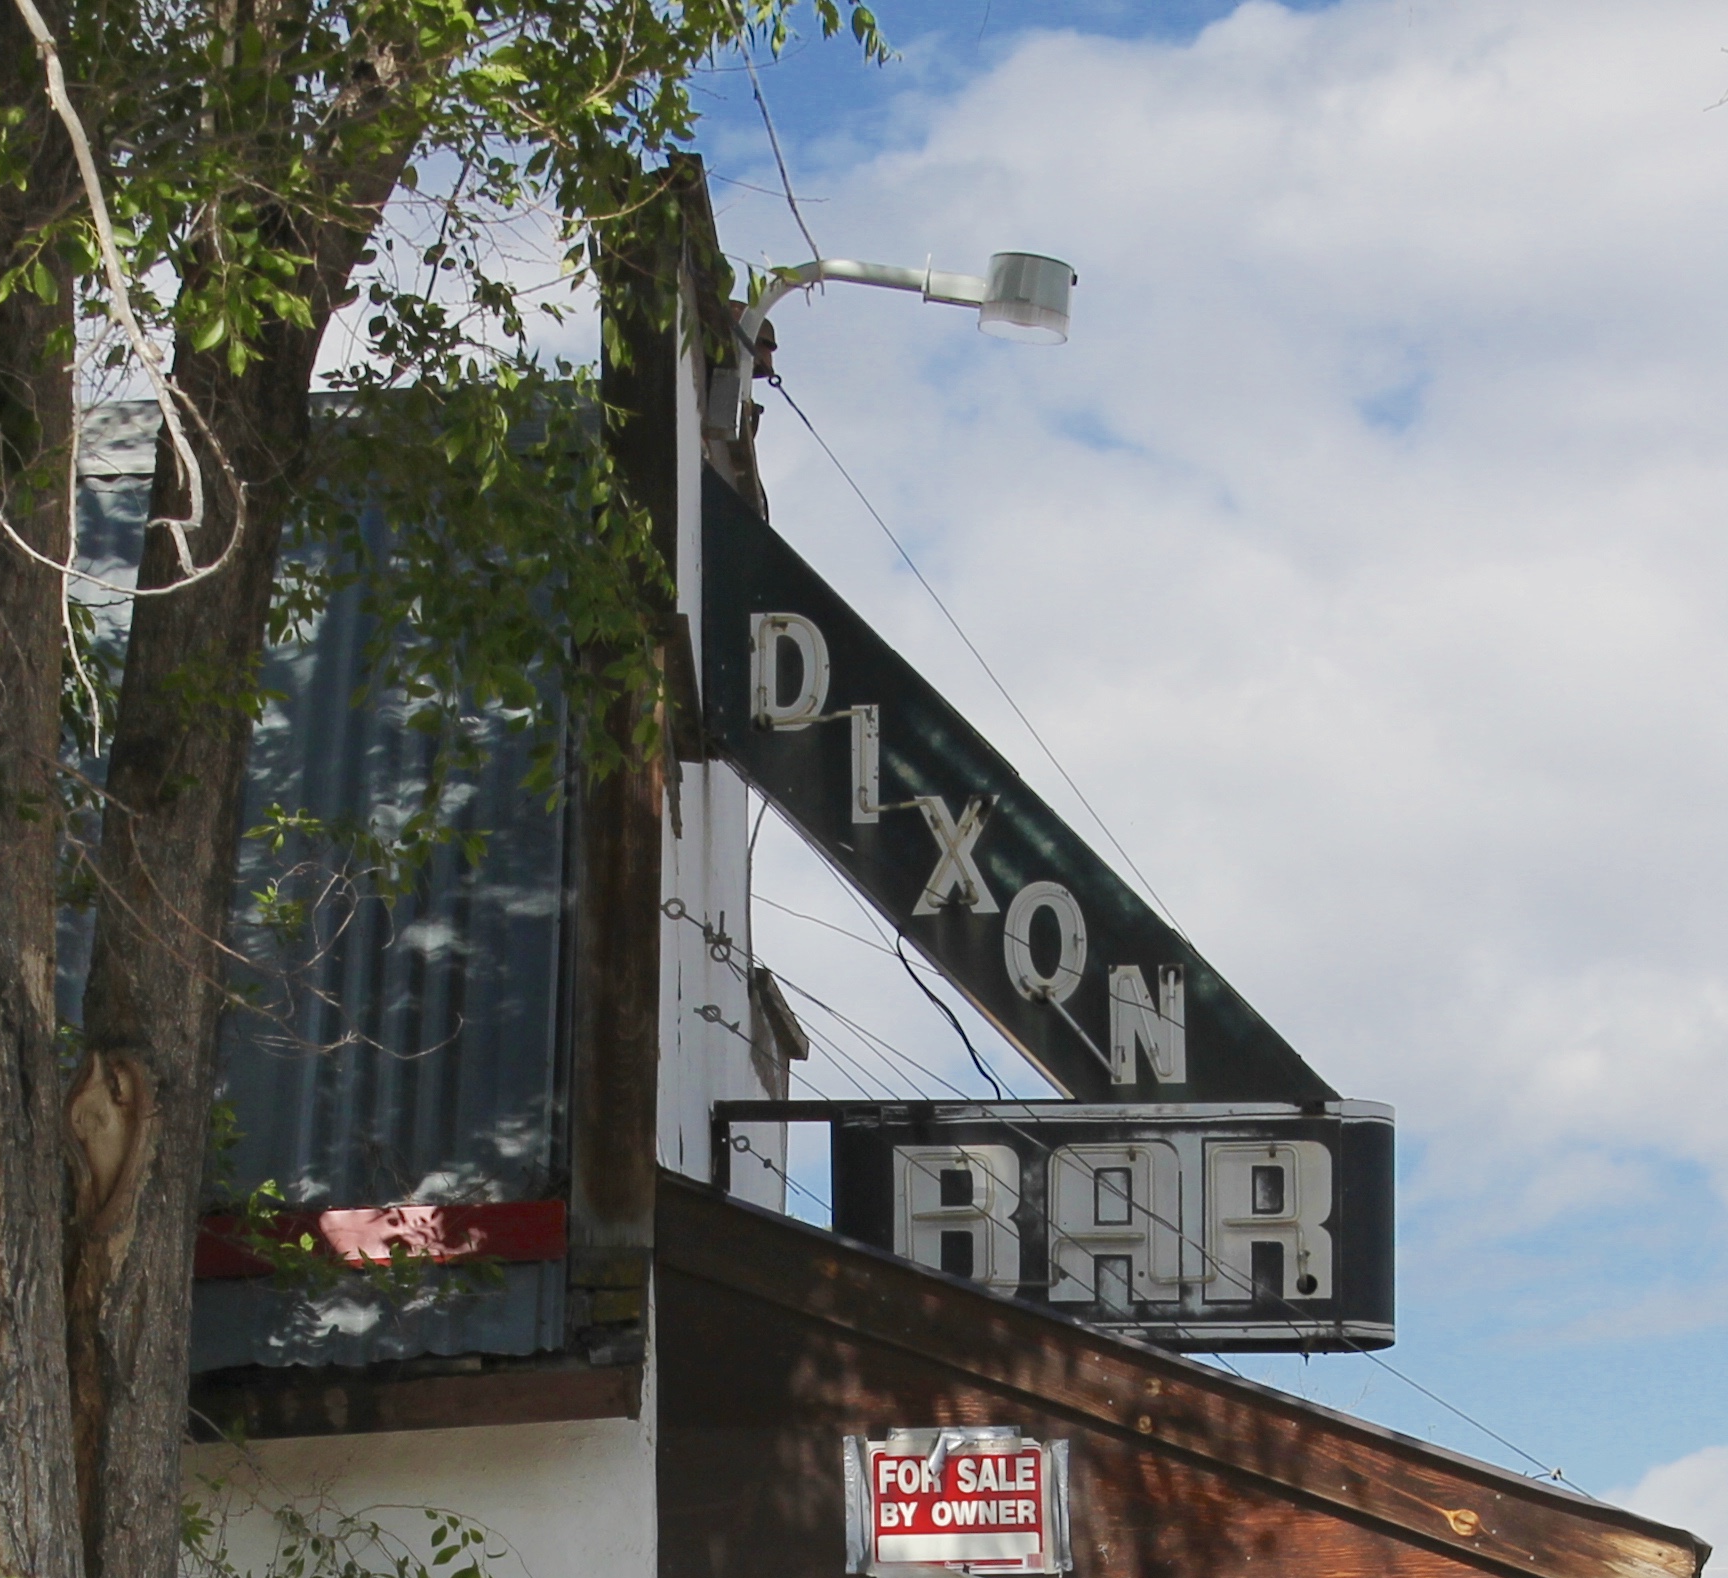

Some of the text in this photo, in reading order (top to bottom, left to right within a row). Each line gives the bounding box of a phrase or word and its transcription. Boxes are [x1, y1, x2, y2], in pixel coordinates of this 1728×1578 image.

[749, 611, 1187, 1085] DIXON
[893, 1140, 1334, 1303] BAR
[879, 1499, 1037, 1528] BY OWNER
[956, 1456, 1036, 1493] SALE
